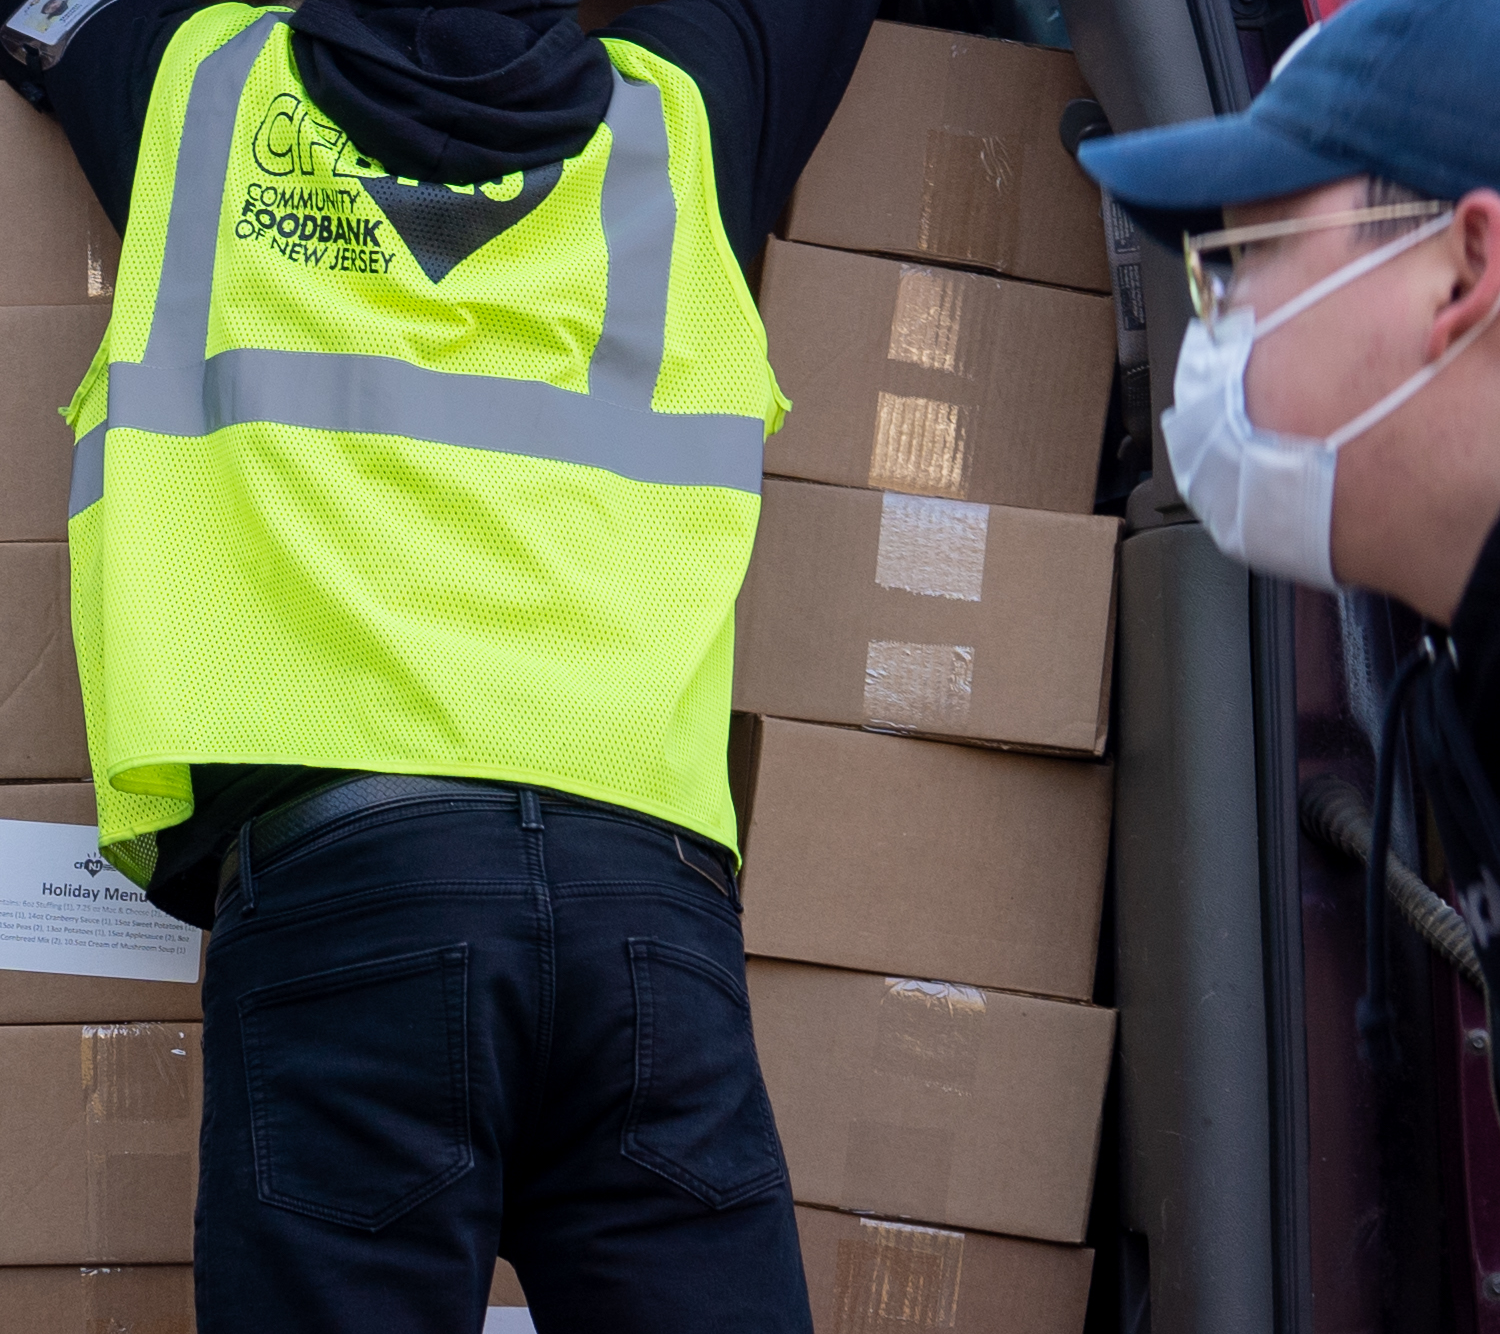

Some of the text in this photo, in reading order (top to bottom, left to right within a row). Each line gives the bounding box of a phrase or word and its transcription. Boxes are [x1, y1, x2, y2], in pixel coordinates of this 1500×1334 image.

[248, 183, 360, 214] COMMUNITY
[242, 199, 383, 248] FOODBANK
[235, 219, 396, 274] OF NEW JERSEY
[42, 883, 147, 903] Holiday Menu
[36, 901, 62, 911] Stuffing
[76, 904, 90, 912] 7.25
[126, 908, 149, 916] Cheese
[45, 914, 79, 923] Cranberry
[154, 922, 183, 930] Potatoes
[64, 927, 93, 935] Potatoes
[125, 932, 163, 940] Applesauce
[0, 934, 35, 942] Cornbread
[65, 938, 86, 946] 10.5oz
[120, 943, 157, 951] Mushroom
[158, 946, 175, 954] Soup
